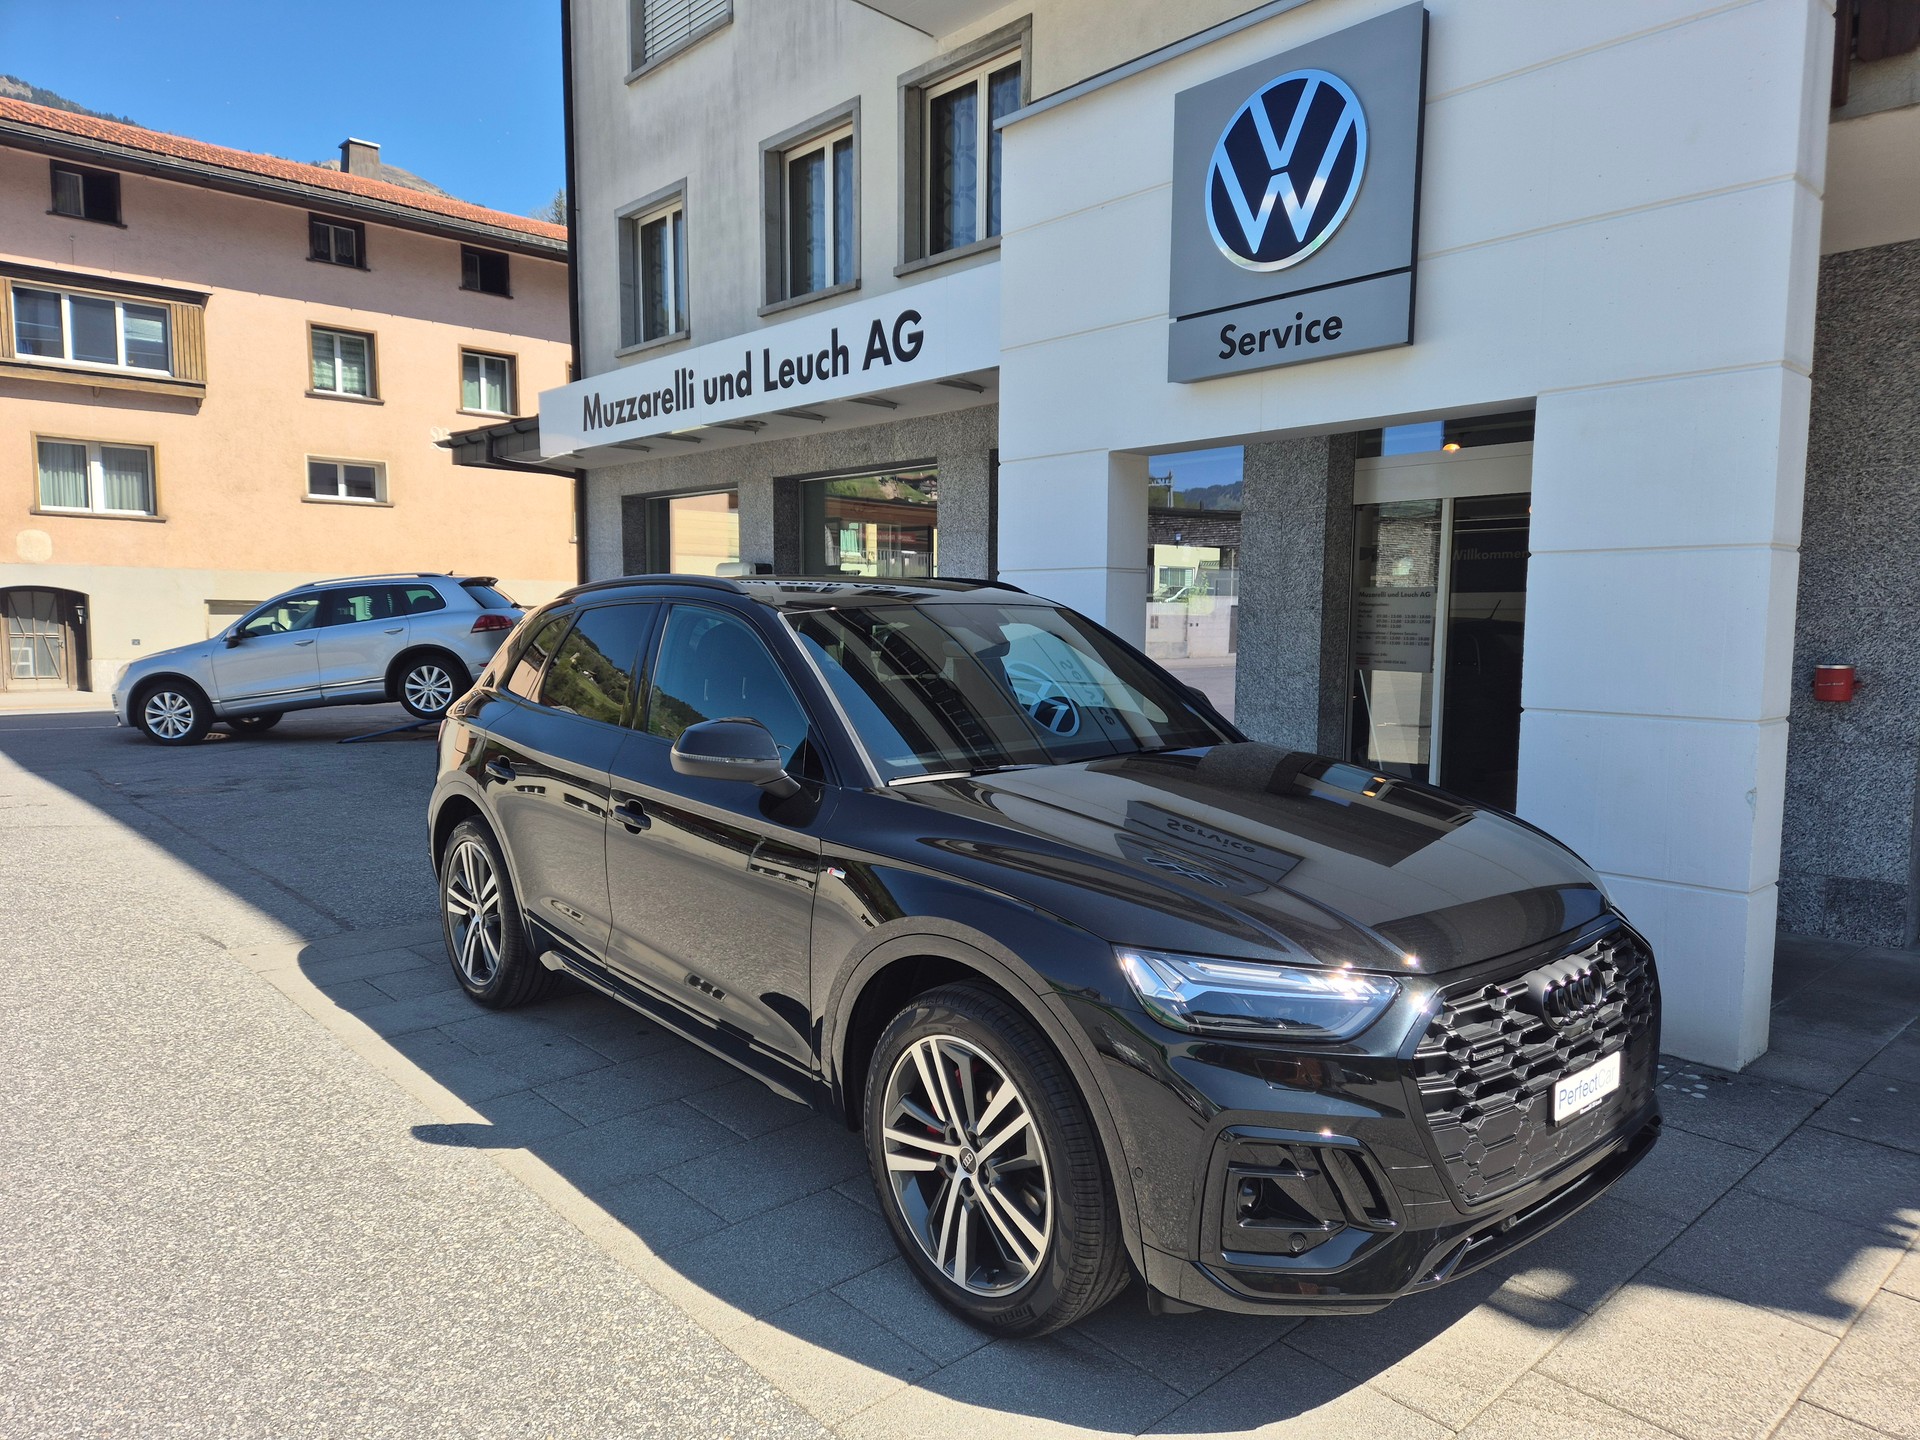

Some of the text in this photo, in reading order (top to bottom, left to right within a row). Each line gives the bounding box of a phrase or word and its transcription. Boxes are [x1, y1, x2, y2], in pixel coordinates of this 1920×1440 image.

[1218, 311, 1343, 360] Service
[583, 309, 925, 432] Muzzarelli und Leuch AG
[1558, 1066, 1616, 1111] PerfectCar
